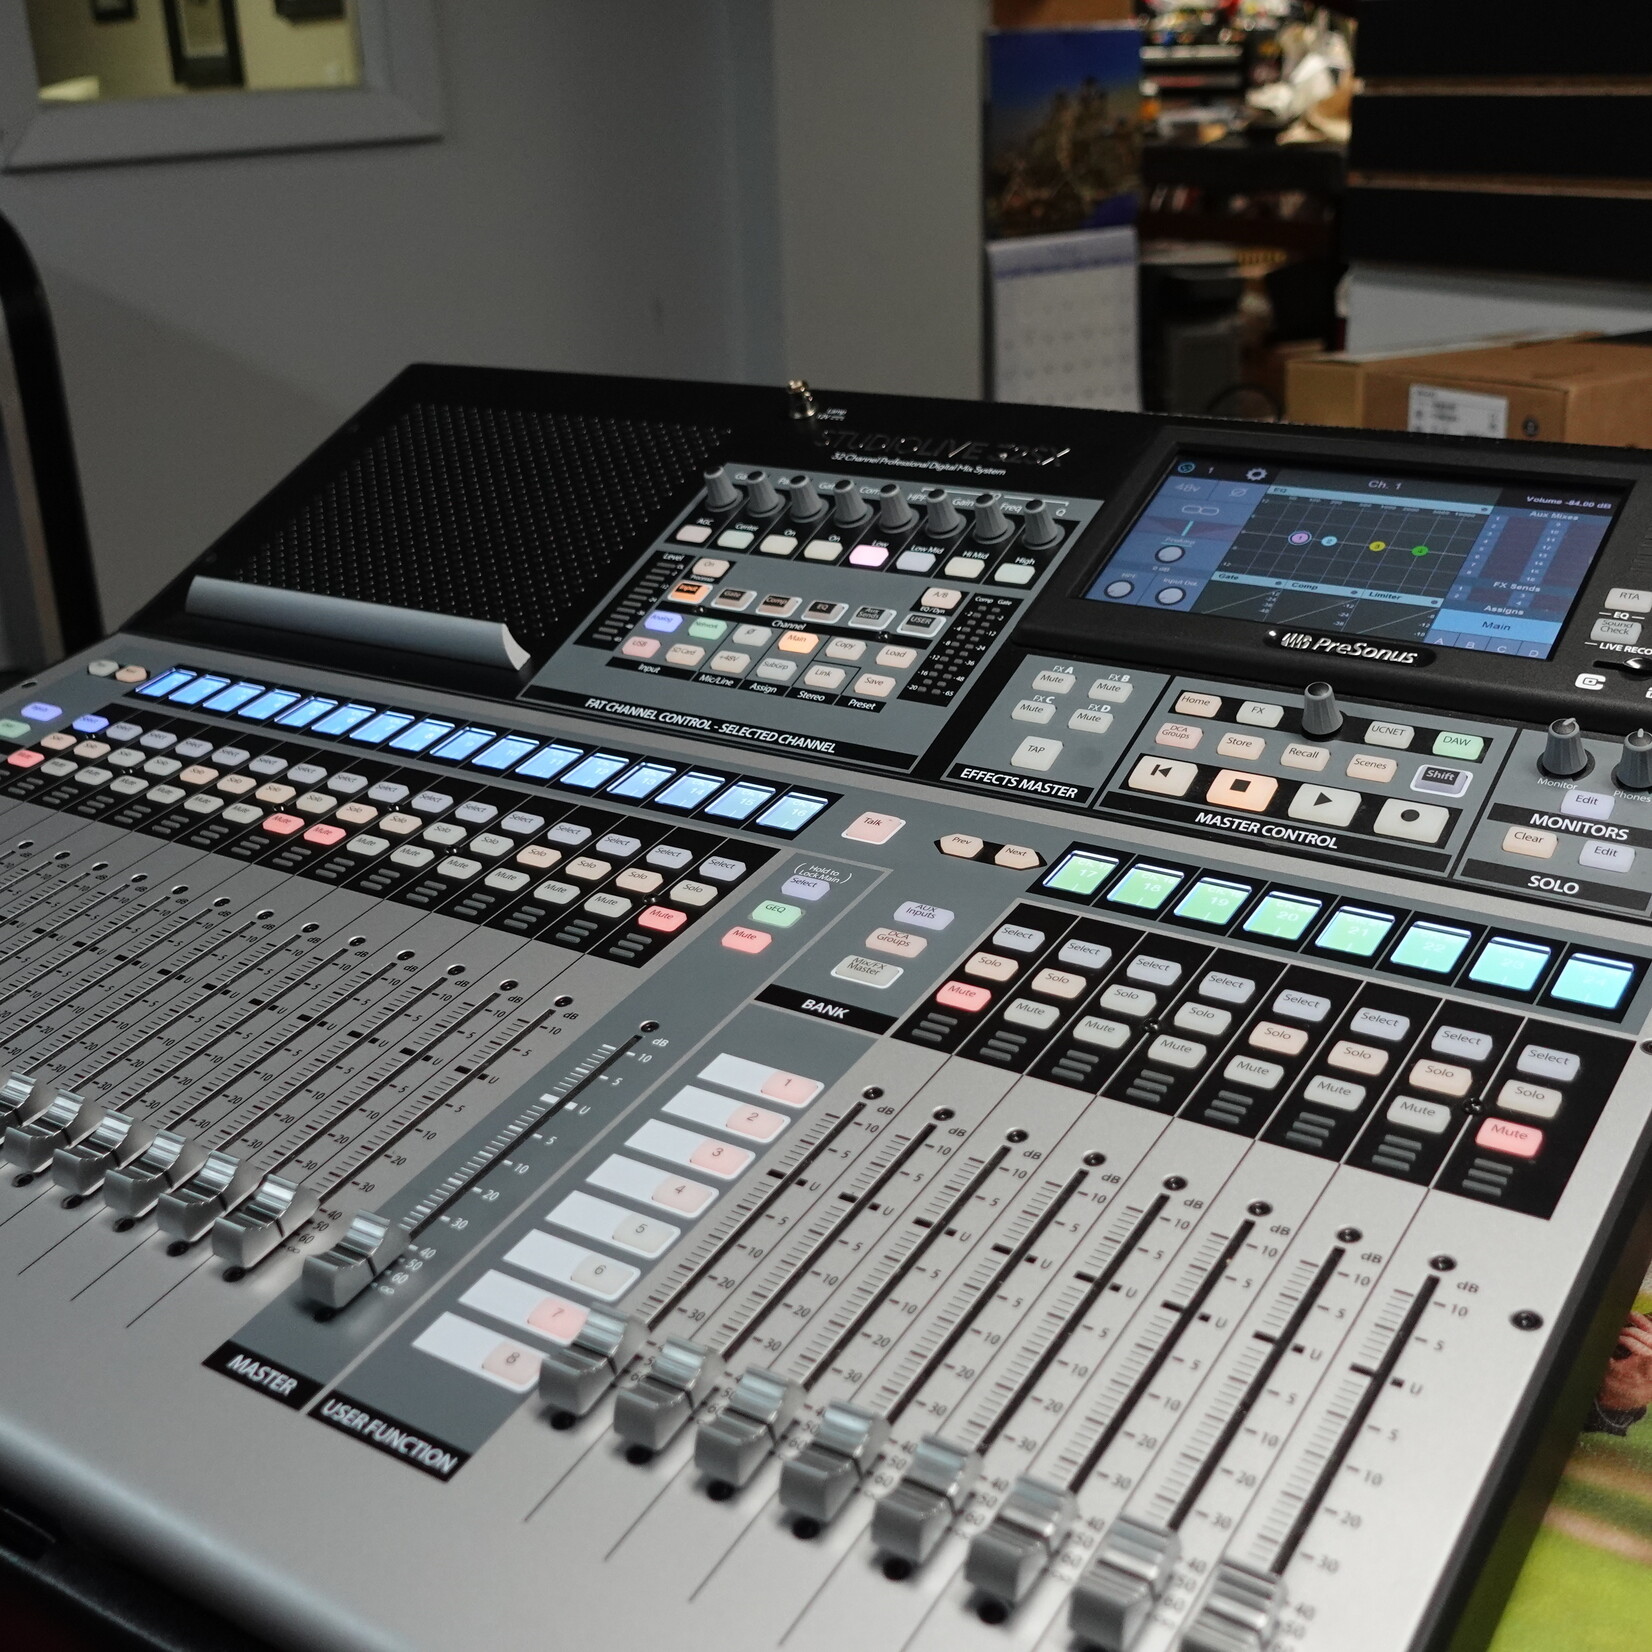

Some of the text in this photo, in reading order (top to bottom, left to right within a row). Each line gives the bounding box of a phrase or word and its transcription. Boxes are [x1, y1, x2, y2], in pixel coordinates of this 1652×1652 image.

[832, 452, 1007, 476] 32 Channel Professional Digital Mix System
[1368, 480, 1402, 490] Ch. 1
[952, 499, 975, 507] Gain
[1526, 496, 1562, 505] Volume
[1001, 502, 1022, 512] Freq
[1551, 512, 1579, 520] Mixes
[735, 523, 759, 531] Center
[911, 545, 944, 554] Low Mid
[1015, 557, 1035, 565] High
[1219, 573, 1239, 581] Gate
[1291, 582, 1318, 591] Comp
[1510, 583, 1541, 592] Sends
[1369, 591, 1402, 601] Limiter
[1620, 592, 1640, 600] RTA
[1484, 605, 1524, 615] Assigns
[911, 616, 932, 624] USER
[1614, 612, 1629, 620] EQ
[772, 620, 807, 630] Channel
[1482, 621, 1511, 631] Main
[1602, 620, 1634, 628] Sound
[1600, 626, 1630, 635] Check
[835, 640, 856, 649] Copy
[1600, 643, 1622, 652] LIVE
[885, 650, 907, 658] Load
[1312, 638, 1418, 664] PreSonus
[638, 664, 661, 674] Input
[764, 661, 789, 669] SubGrp
[699, 675, 734, 686] Mic/Line
[1040, 675, 1064, 683] Mute
[1121, 674, 1130, 682] B
[749, 683, 777, 694] Assign
[1097, 683, 1121, 693] Mute
[797, 691, 825, 701] Stereo
[1181, 695, 1210, 706] Home
[848, 699, 876, 710] Preset
[1020, 704, 1044, 713] Mute
[1101, 704, 1111, 713] D
[1077, 713, 1101, 722] Mute
[585, 698, 836, 753] FAT CHANNEL CONTROL SELECTED CHANNEL
[1372, 725, 1406, 736] UCNET
[1162, 730, 1190, 739] Groups
[1226, 737, 1252, 747] Store
[1443, 736, 1472, 746] DAW
[1028, 745, 1045, 753] TAP
[1288, 748, 1319, 758] Recall
[1354, 758, 1387, 769] Scenes
[1426, 769, 1455, 781] Shift
[960, 768, 1078, 798] EFFECTS MASTER
[1537, 778, 1578, 791] Monitor
[1575, 795, 1599, 806] Edit
[1613, 790, 1651, 802] Phones
[463, 803, 486, 814] Select
[273, 815, 293, 827] Mute
[863, 817, 883, 827] Talk
[556, 822, 581, 835] Select
[1195, 812, 1338, 848] MASTER CONTROL
[1530, 814, 1630, 841] MONITORS
[951, 836, 971, 846] Prev
[1514, 832, 1544, 843] Clear
[529, 848, 547, 858] Solo
[655, 846, 681, 858] Select
[1005, 847, 1026, 858] Next
[1594, 846, 1618, 857] Edit
[708, 858, 736, 871] Select
[809, 865, 829, 873] Hold
[495, 871, 517, 882] Mute
[628, 870, 648, 881] Solo
[799, 869, 840, 883] Lock Main
[1080, 868, 1098, 878] 17
[791, 877, 817, 887] Select
[1528, 875, 1579, 894] SOLO
[682, 882, 703, 894] Solo
[765, 903, 786, 913] GEQ
[905, 907, 937, 919] Inputs
[916, 904, 935, 913] AUX
[650, 908, 674, 921] Mute
[733, 929, 757, 940] Mute
[887, 930, 908, 940] DCA
[1001, 927, 1033, 940] Select
[877, 934, 910, 947] Groups
[1067, 942, 1099, 956] Select
[853, 957, 886, 970] Mix/FX
[978, 956, 1002, 968] Solo
[847, 962, 880, 976] Master
[1209, 974, 1244, 989] Select
[947, 984, 977, 998] Mute
[801, 999, 849, 1019] BANK
[1016, 1002, 1045, 1015] Mute
[1361, 1011, 1399, 1028] Select
[1264, 1027, 1291, 1040] Solo
[652, 1037, 669, 1047] dB
[638, 1054, 652, 1063] 10
[1343, 1046, 1372, 1060] Solo
[1528, 1049, 1570, 1066] Select
[1515, 1086, 1545, 1101] Solo
[876, 1104, 894, 1115] dB
[747, 1112, 759, 1122] 2
[1491, 1124, 1528, 1141] Mute
[390, 1154, 407, 1166] 20
[809, 1181, 820, 1192] U
[482, 1189, 500, 1200] 20
[1457, 1281, 1480, 1294] dB
[553, 1308, 565, 1318] 7
[505, 1351, 520, 1364] 8
[227, 1354, 298, 1396] MASTER
[320, 1399, 458, 1474] USER FUNCTION
